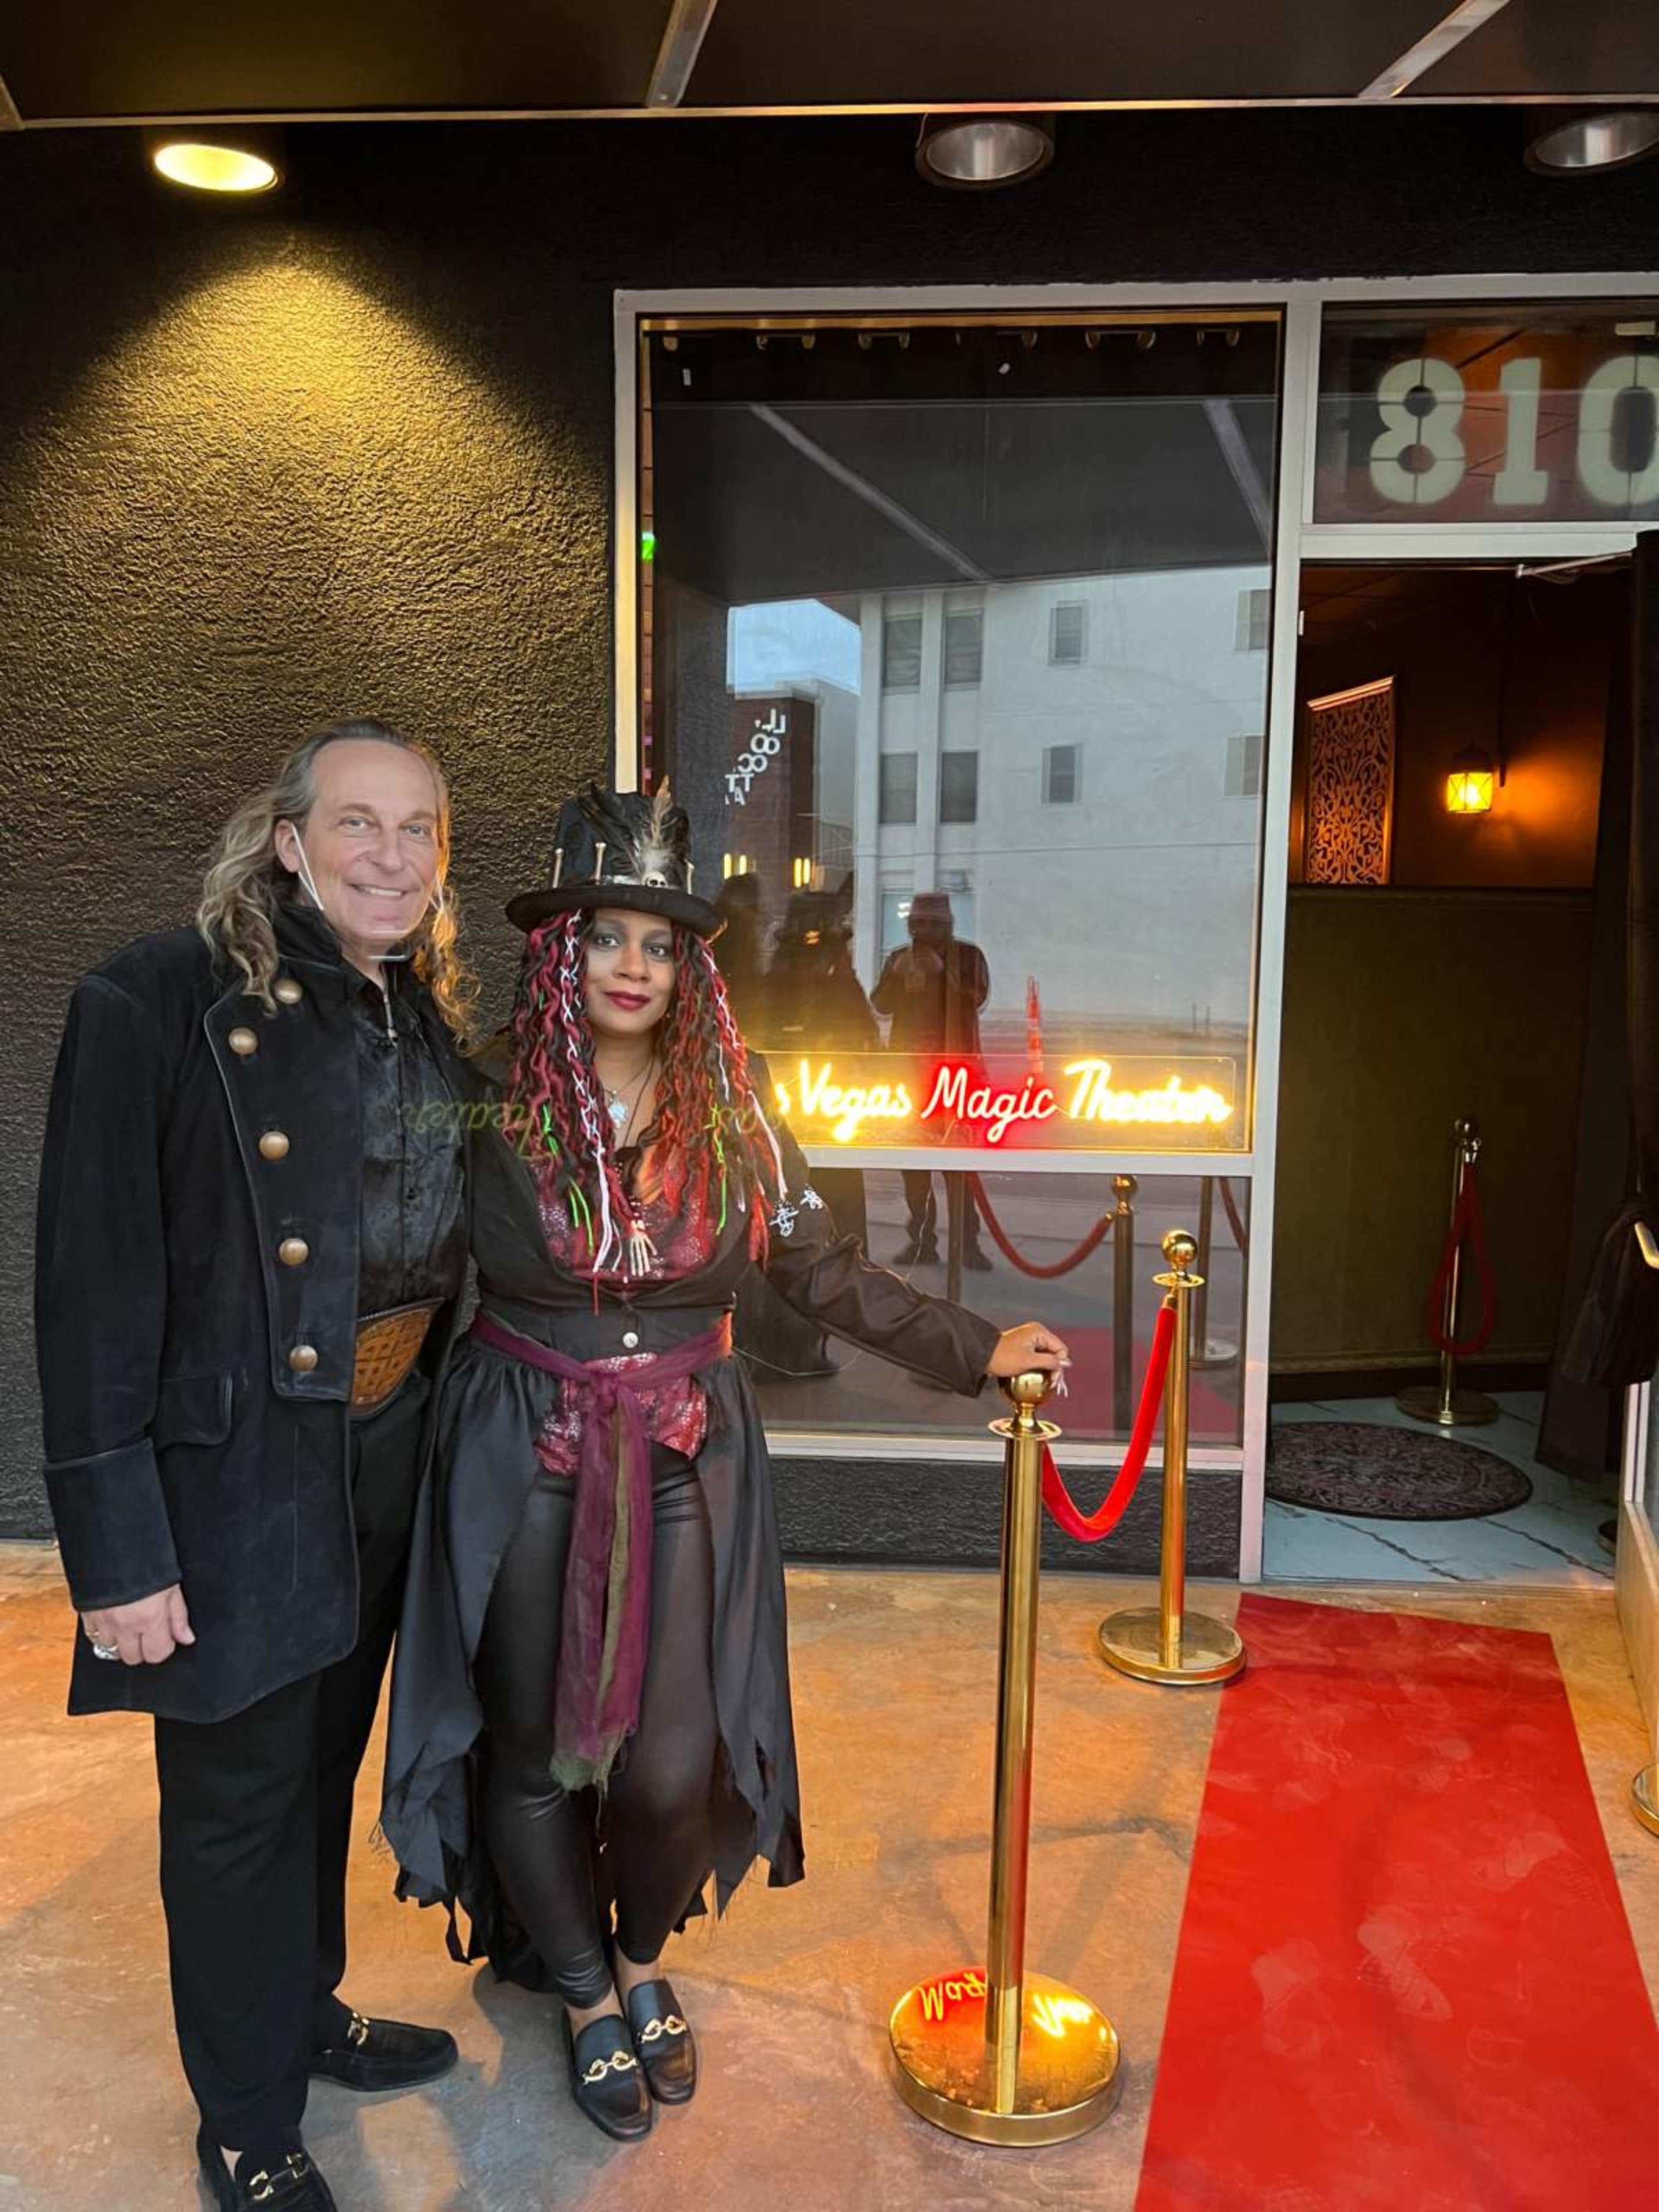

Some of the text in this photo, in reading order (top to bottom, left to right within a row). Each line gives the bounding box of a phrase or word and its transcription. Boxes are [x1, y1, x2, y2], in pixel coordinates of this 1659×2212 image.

[1370, 356, 1659, 505] 810
[798, 1058, 911, 1142] Vegas
[921, 1065, 1057, 1143] Magic
[1065, 1058, 1232, 1123] Theater
